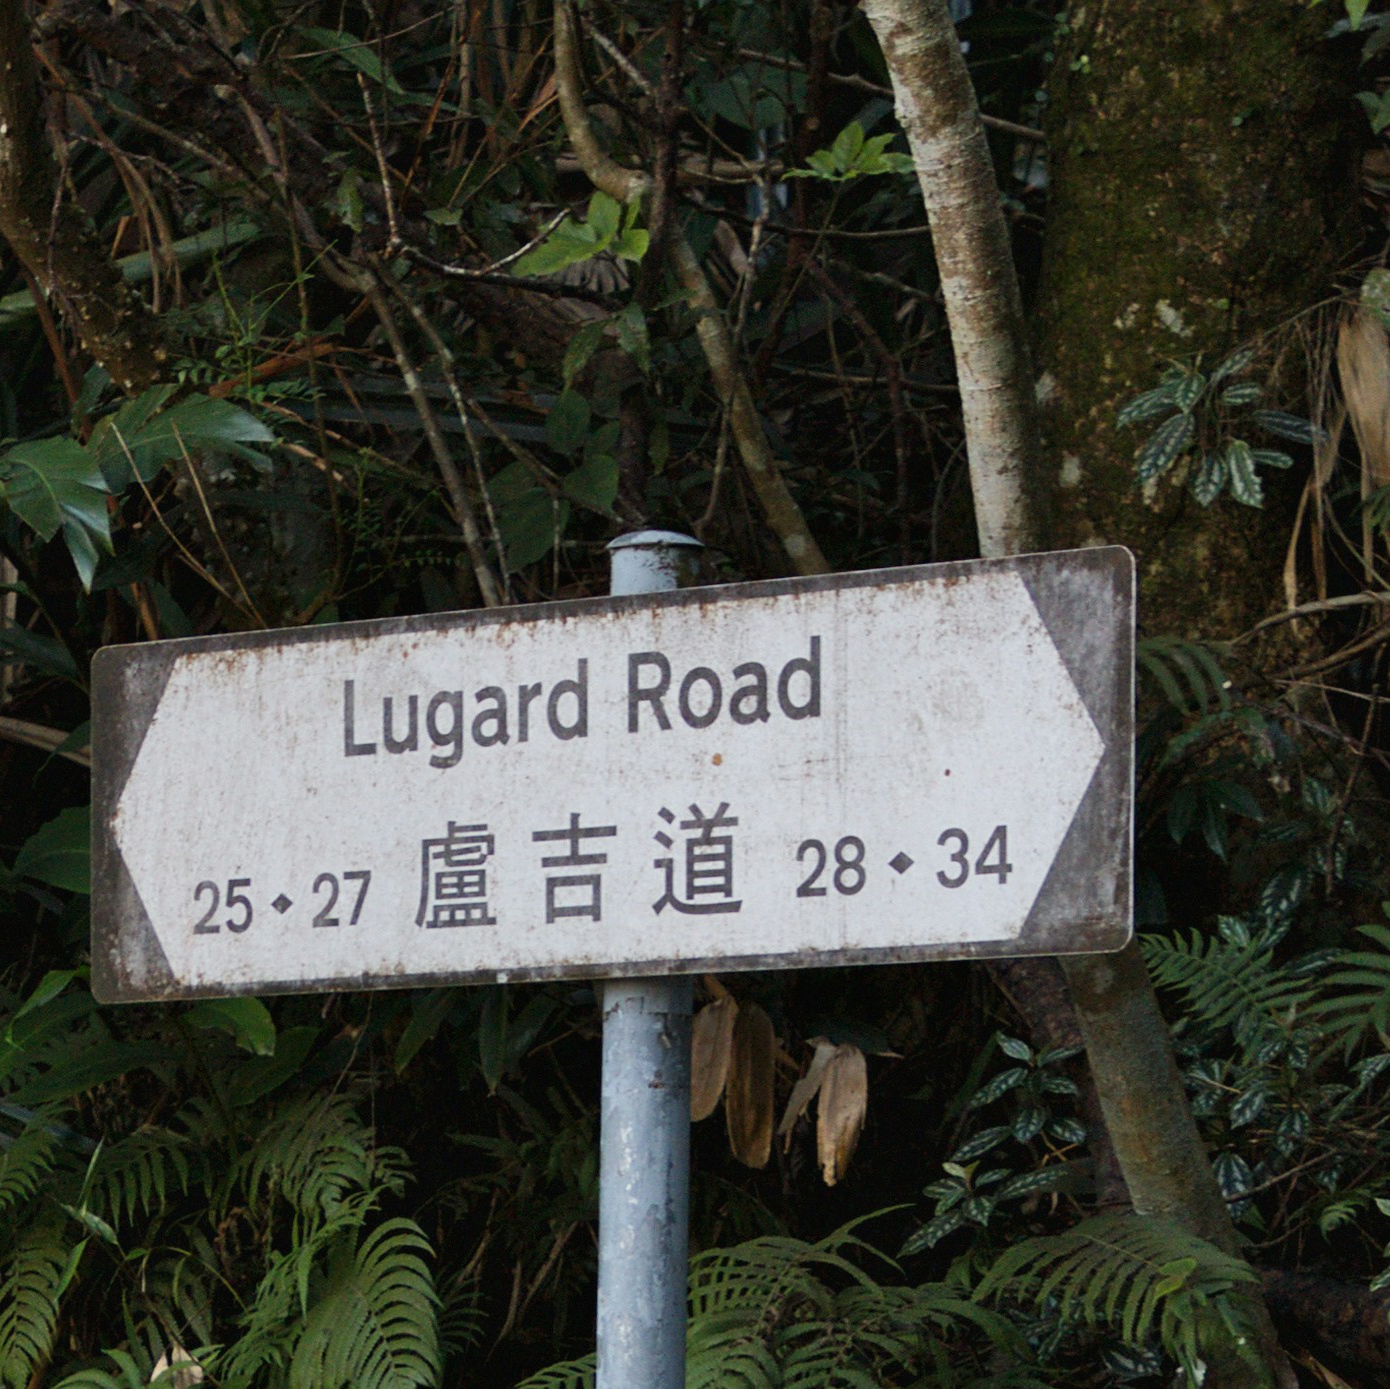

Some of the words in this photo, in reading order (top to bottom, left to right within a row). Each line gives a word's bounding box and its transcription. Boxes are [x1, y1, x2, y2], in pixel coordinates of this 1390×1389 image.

[343, 658, 588, 769] Lugard
[628, 636, 821, 733] Road
[415, 802, 742, 929] 盧吉道
